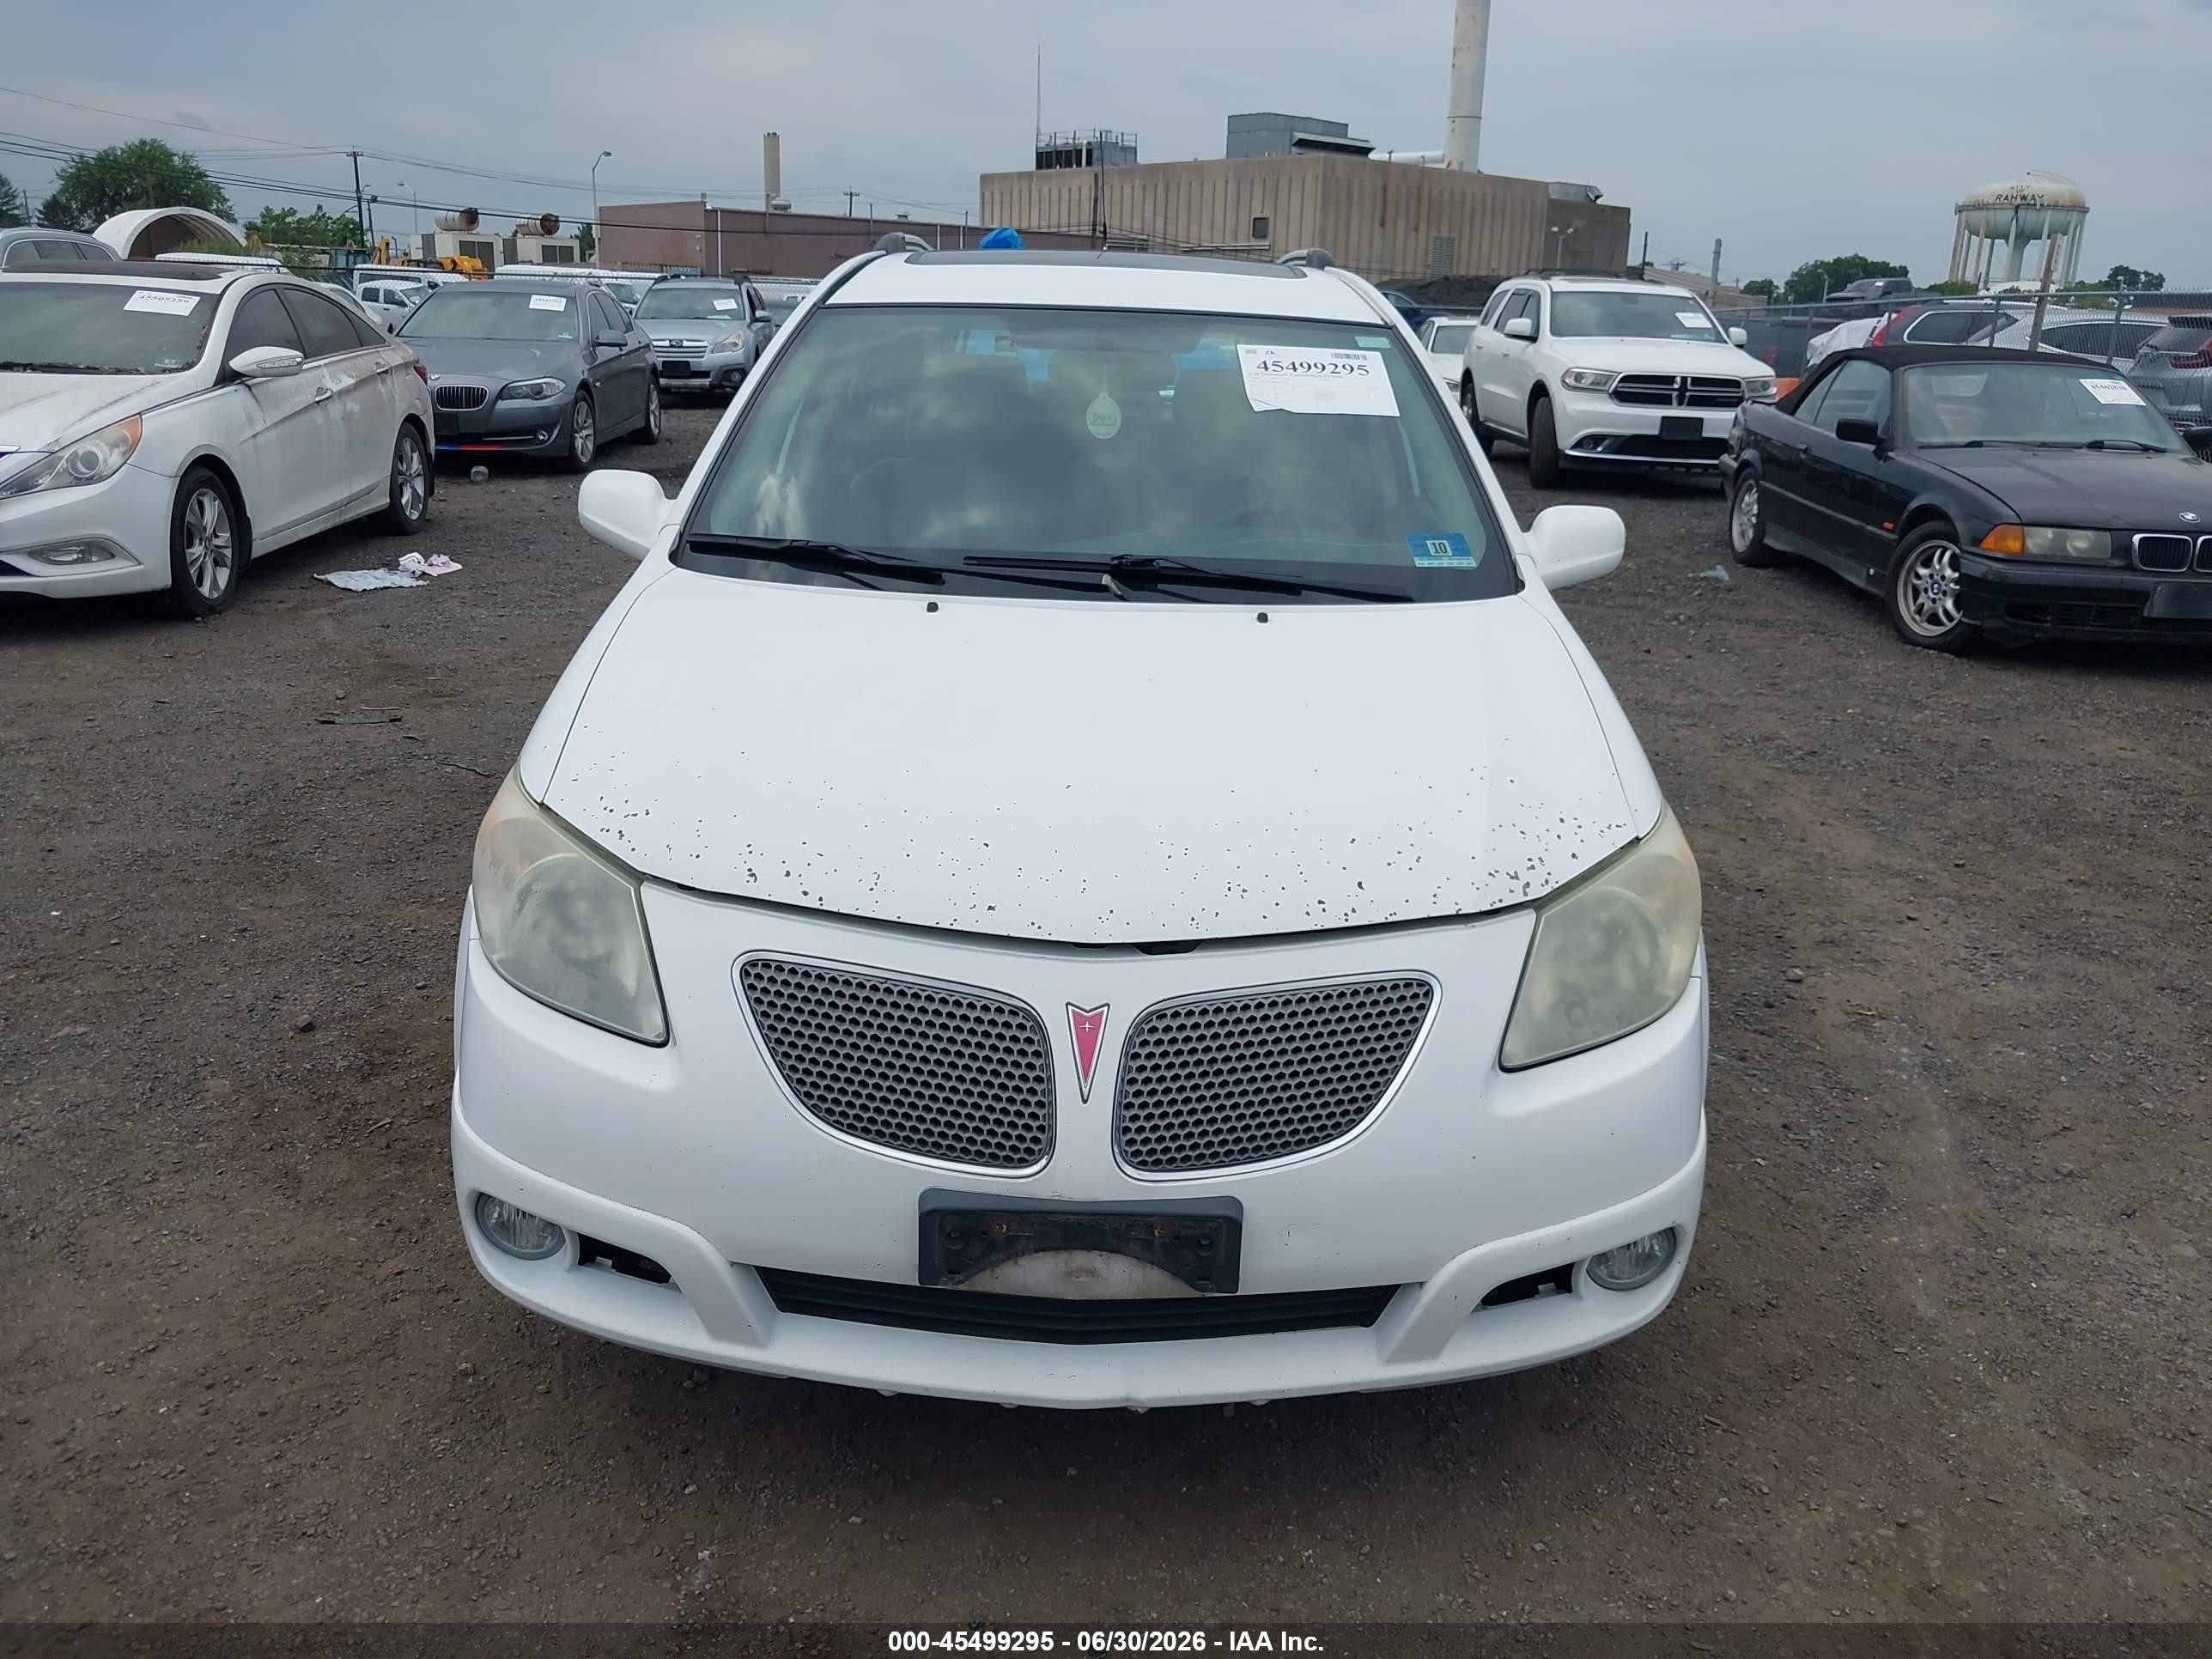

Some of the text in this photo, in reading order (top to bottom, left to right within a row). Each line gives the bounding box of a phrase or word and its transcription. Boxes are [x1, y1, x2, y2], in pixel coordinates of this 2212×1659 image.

[1995, 193, 2045, 203] RAHWAY
[1256, 360, 1370, 376] 45499295
[1430, 542, 1449, 555] 10
